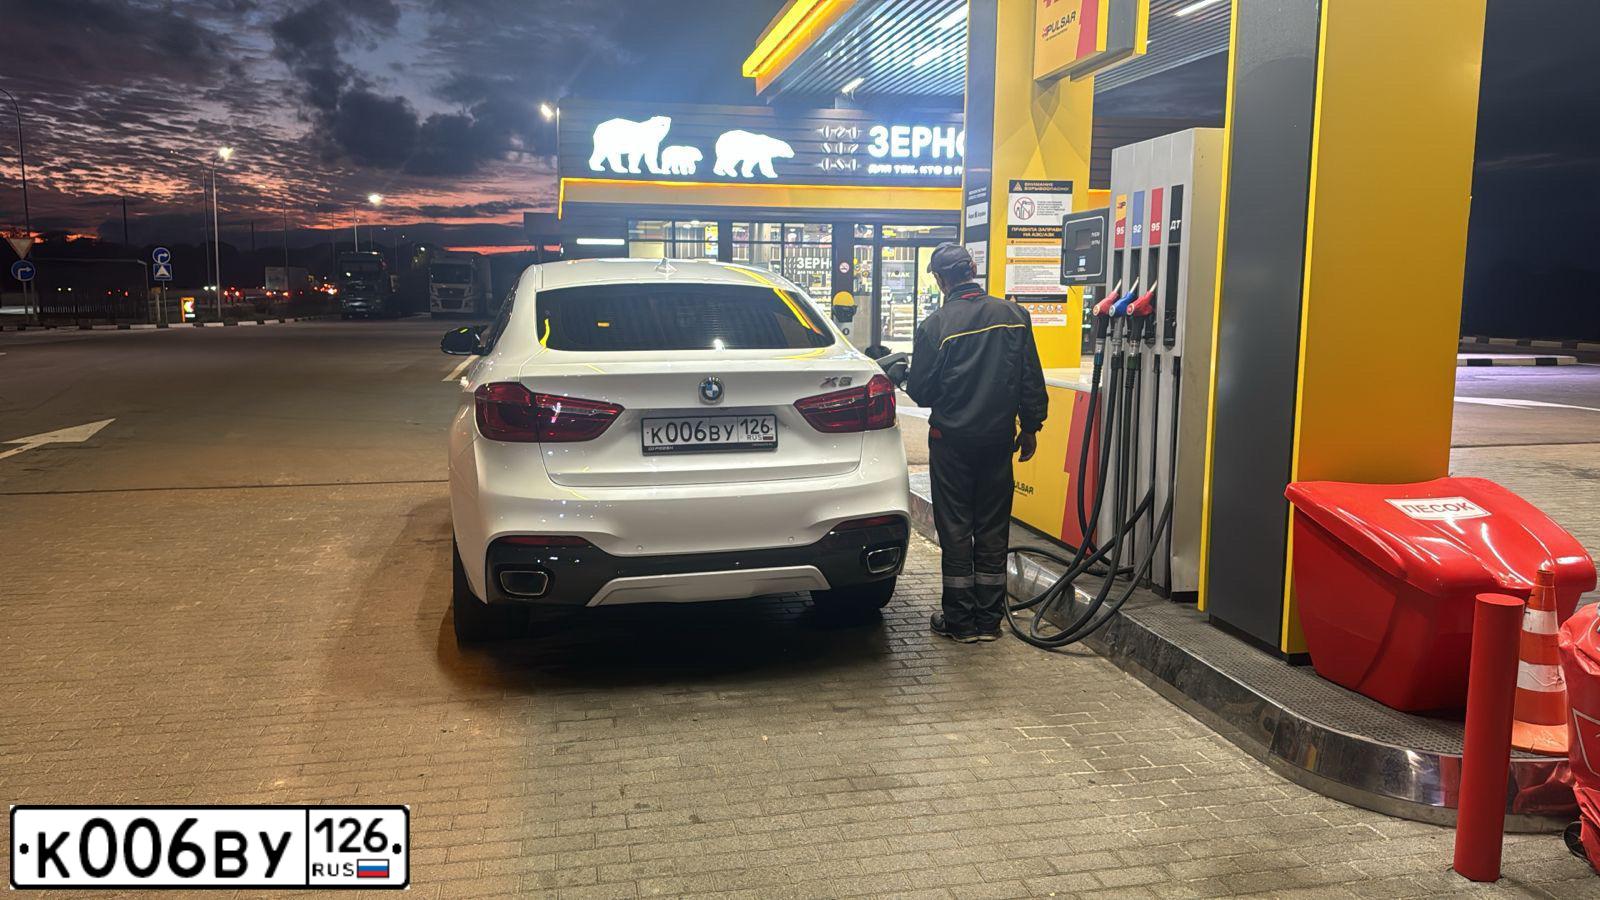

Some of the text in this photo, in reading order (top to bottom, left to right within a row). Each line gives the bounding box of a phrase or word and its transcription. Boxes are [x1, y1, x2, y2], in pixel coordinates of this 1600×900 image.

[1045, 10, 1077, 35] PULSAR
[1116, 226, 1125, 235] 95
[1133, 224, 1142, 234] 92
[1151, 222, 1160, 232] 95
[1170, 220, 1181, 231] ДТ
[796, 257, 832, 270] ЗЕРН
[650, 419, 770, 445] К006ВУ 126
[1013, 481, 1033, 494] ULSAR
[1402, 502, 1474, 513] ПЕСОК
